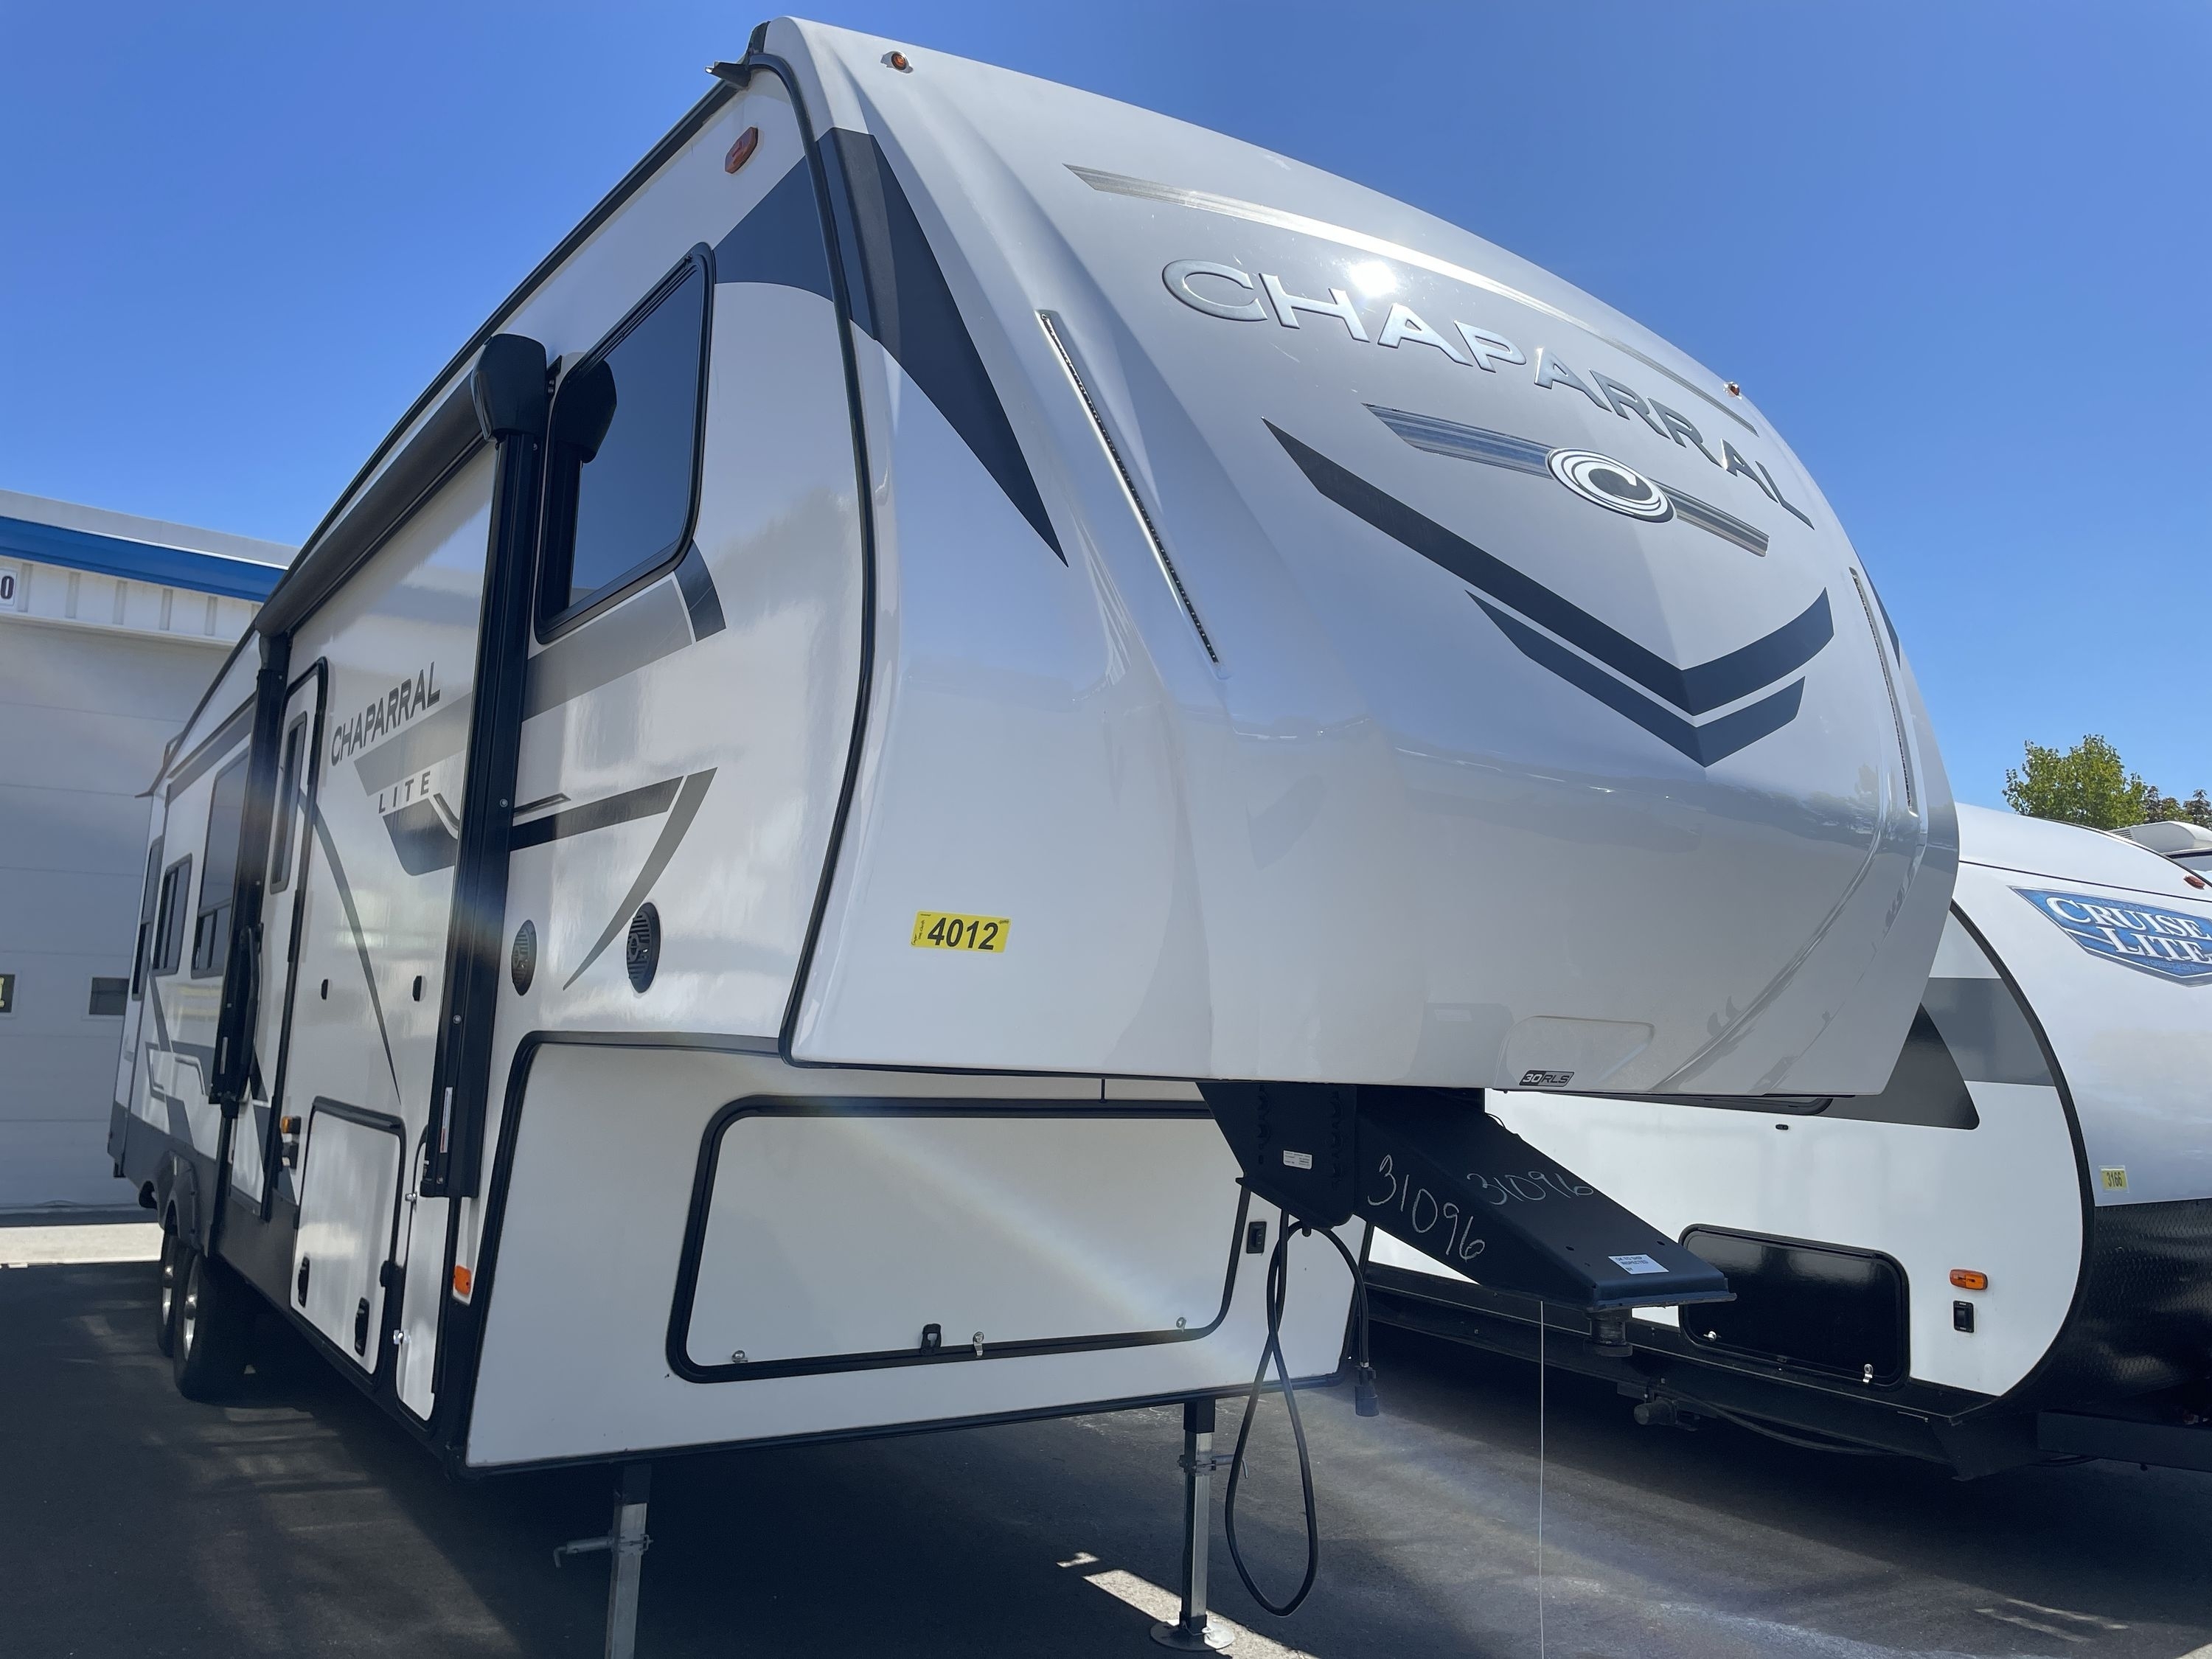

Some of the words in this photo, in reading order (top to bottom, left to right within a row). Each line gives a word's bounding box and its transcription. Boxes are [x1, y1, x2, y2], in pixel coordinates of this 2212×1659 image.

[1162, 259, 1815, 531] CHAPARRAL
[0, 575, 15, 599] 0
[332, 661, 440, 766] CHAPARRAL
[378, 771, 431, 814] LITE
[927, 917, 998, 950] 4012
[2046, 897, 2212, 940] CRUISE
[2096, 926, 2212, 964] LITE
[1467, 1171, 1594, 1206] 31096
[2107, 1172, 2123, 1187] 3166
[1368, 1154, 1486, 1262] 31096
